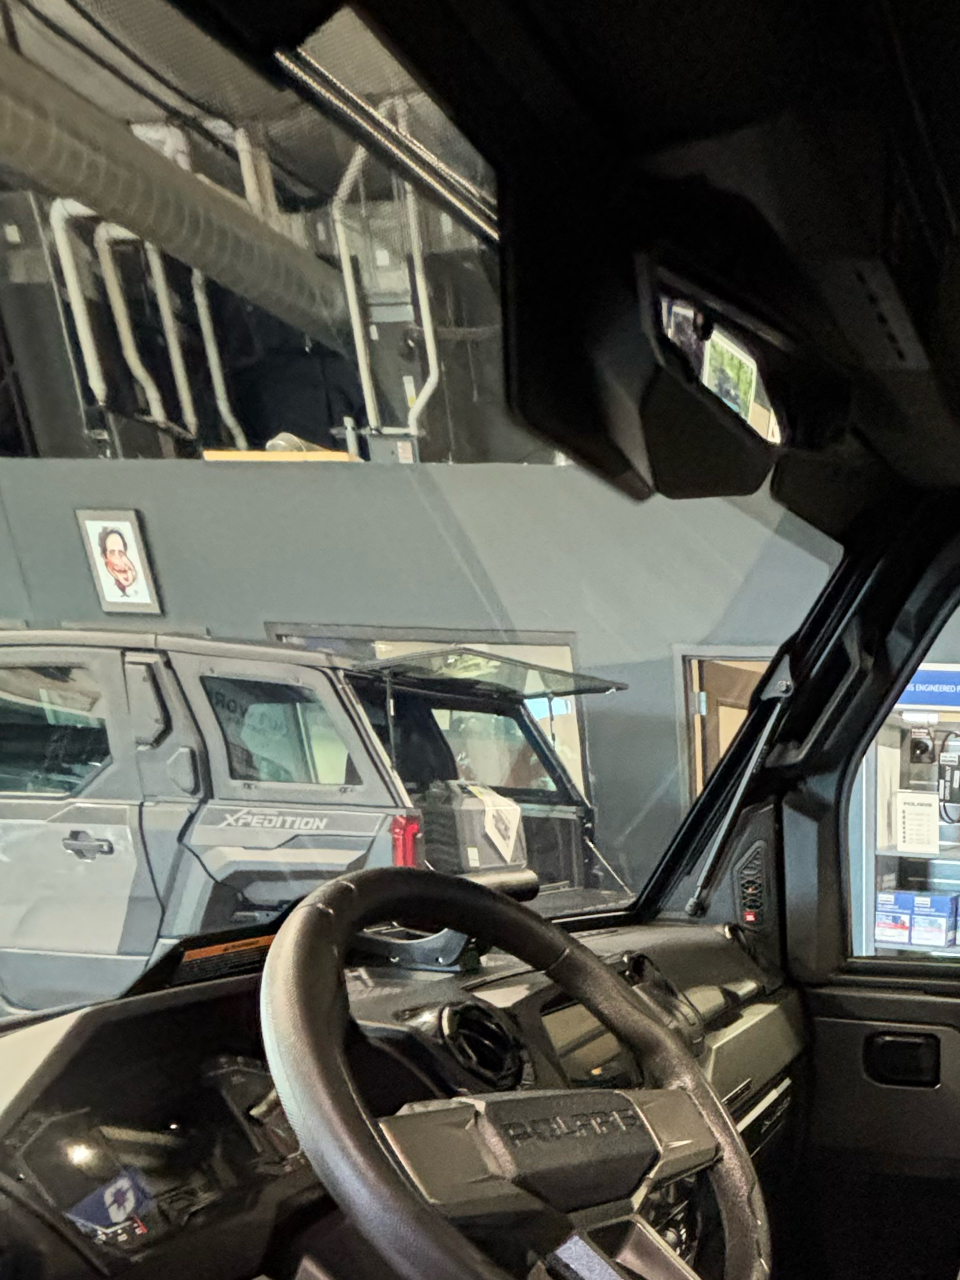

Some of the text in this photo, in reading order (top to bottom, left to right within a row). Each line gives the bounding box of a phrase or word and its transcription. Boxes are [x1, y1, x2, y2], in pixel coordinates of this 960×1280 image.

[915, 684, 956, 693] ENGINEERED
[218, 809, 328, 830] XPEDITION
[500, 1108, 642, 1147] POLARIS
